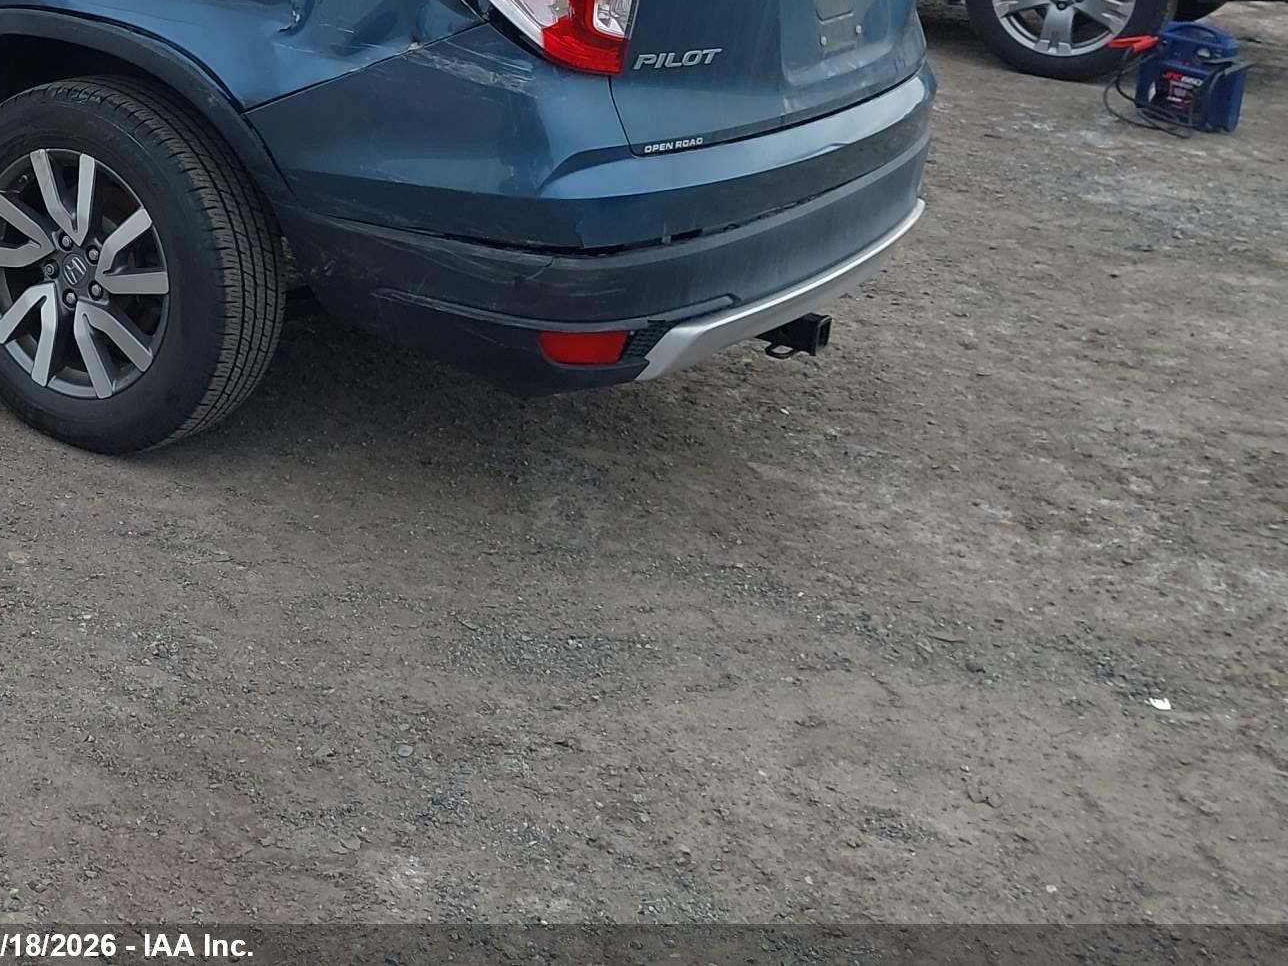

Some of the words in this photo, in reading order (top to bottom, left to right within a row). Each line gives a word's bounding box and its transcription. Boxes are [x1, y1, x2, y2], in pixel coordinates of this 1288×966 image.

[633, 48, 723, 70] PILOT
[644, 140, 674, 154] OPEN
[675, 137, 704, 150] ROAD
